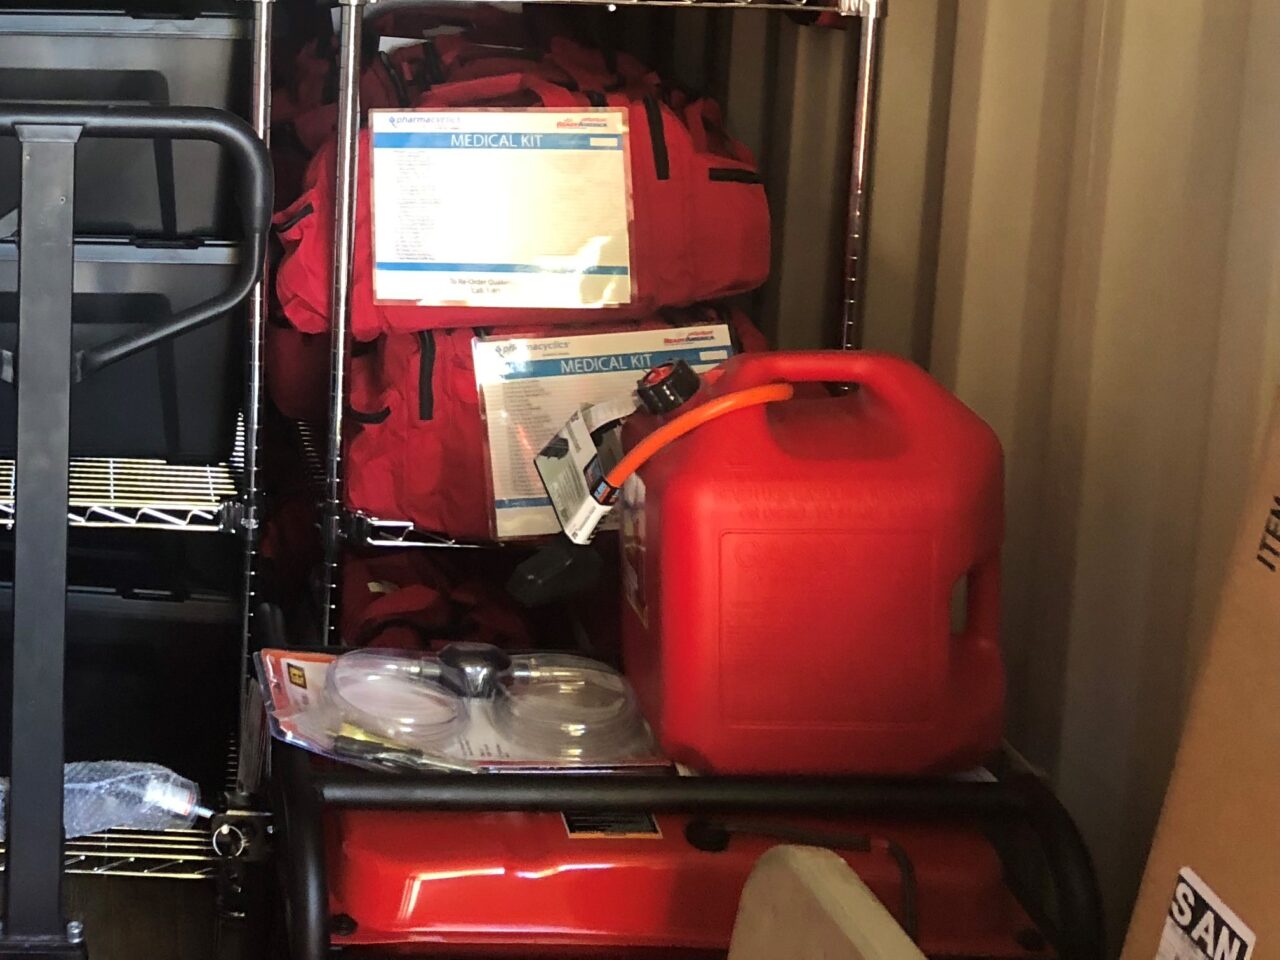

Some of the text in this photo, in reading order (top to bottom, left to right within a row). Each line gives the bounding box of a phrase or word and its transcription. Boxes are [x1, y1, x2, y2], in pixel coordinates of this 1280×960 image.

[450, 134, 544, 148] MEDICAL KIT
[560, 353, 653, 375] MEDICAL KIT
[1171, 882, 1241, 960] SAN
